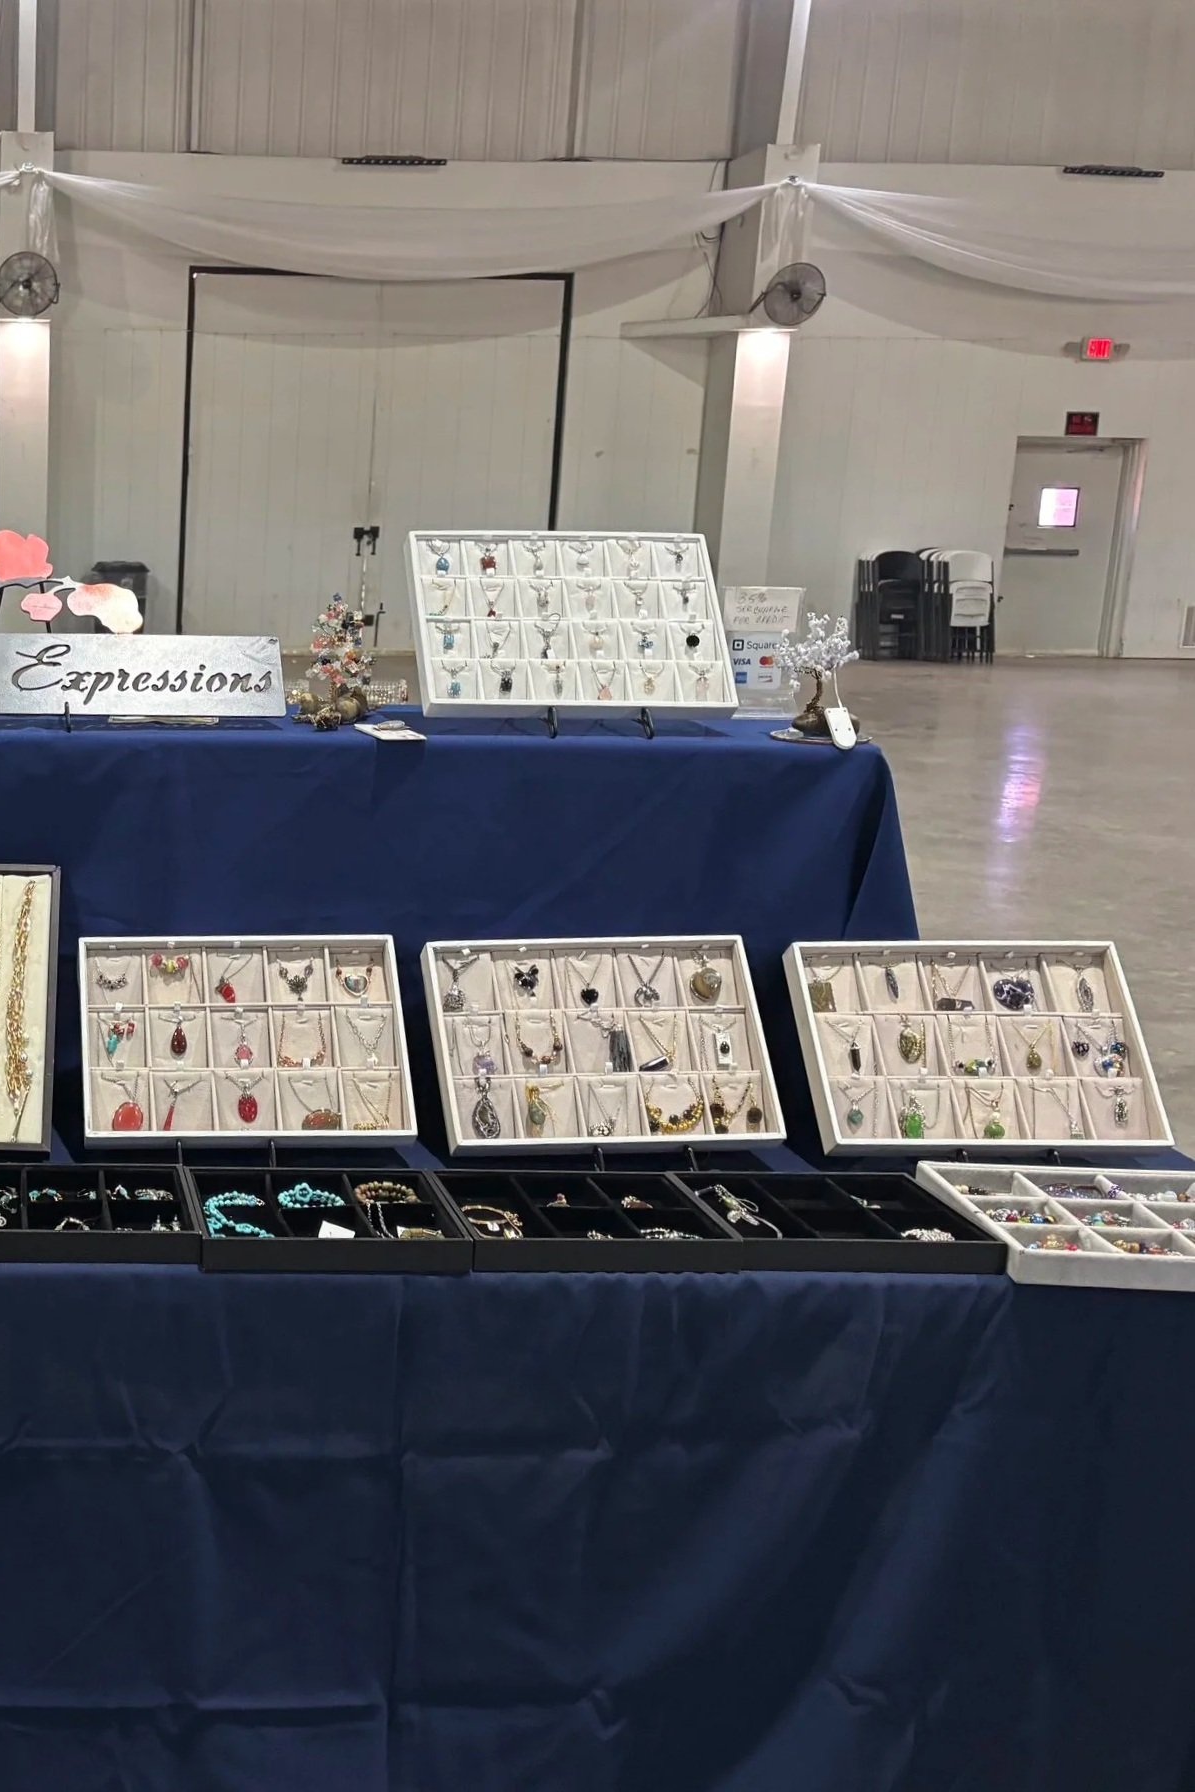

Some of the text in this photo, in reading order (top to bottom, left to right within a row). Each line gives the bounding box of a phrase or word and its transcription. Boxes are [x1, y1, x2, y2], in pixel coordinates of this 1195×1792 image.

[746, 640, 778, 650] Square
[733, 657, 751, 666] VISA
[11, 643, 273, 705] Expressions
